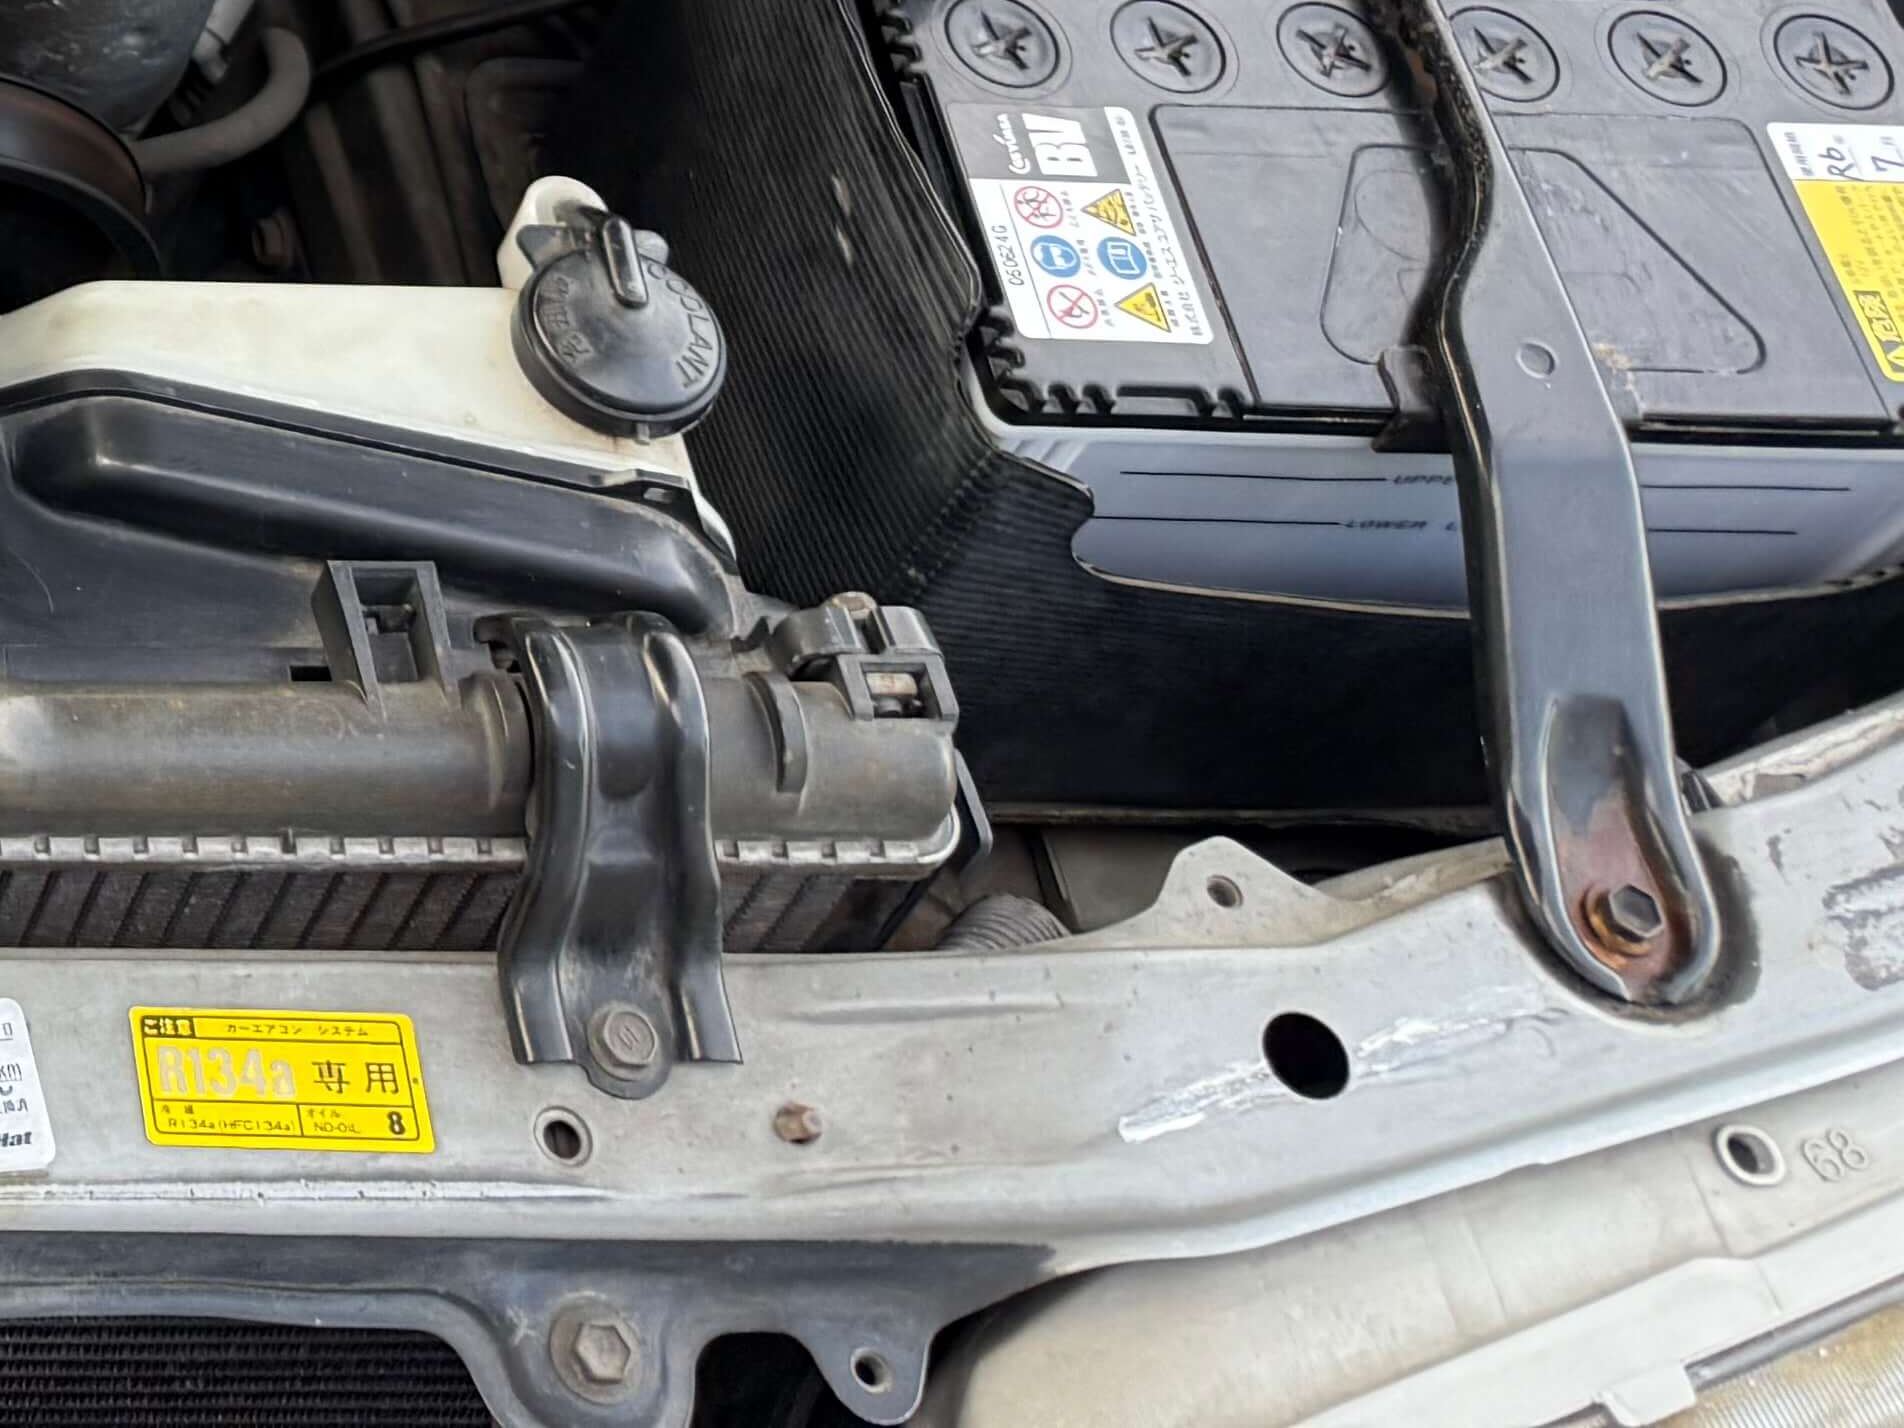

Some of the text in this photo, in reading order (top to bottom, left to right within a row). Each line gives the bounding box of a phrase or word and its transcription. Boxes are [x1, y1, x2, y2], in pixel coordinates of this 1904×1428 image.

[1022, 112, 1099, 177] BV
[646, 261, 714, 389] COOLANT
[317, 1025, 370, 1037] システム
[155, 1045, 298, 1099] R134a
[385, 1110, 407, 1137] 8
